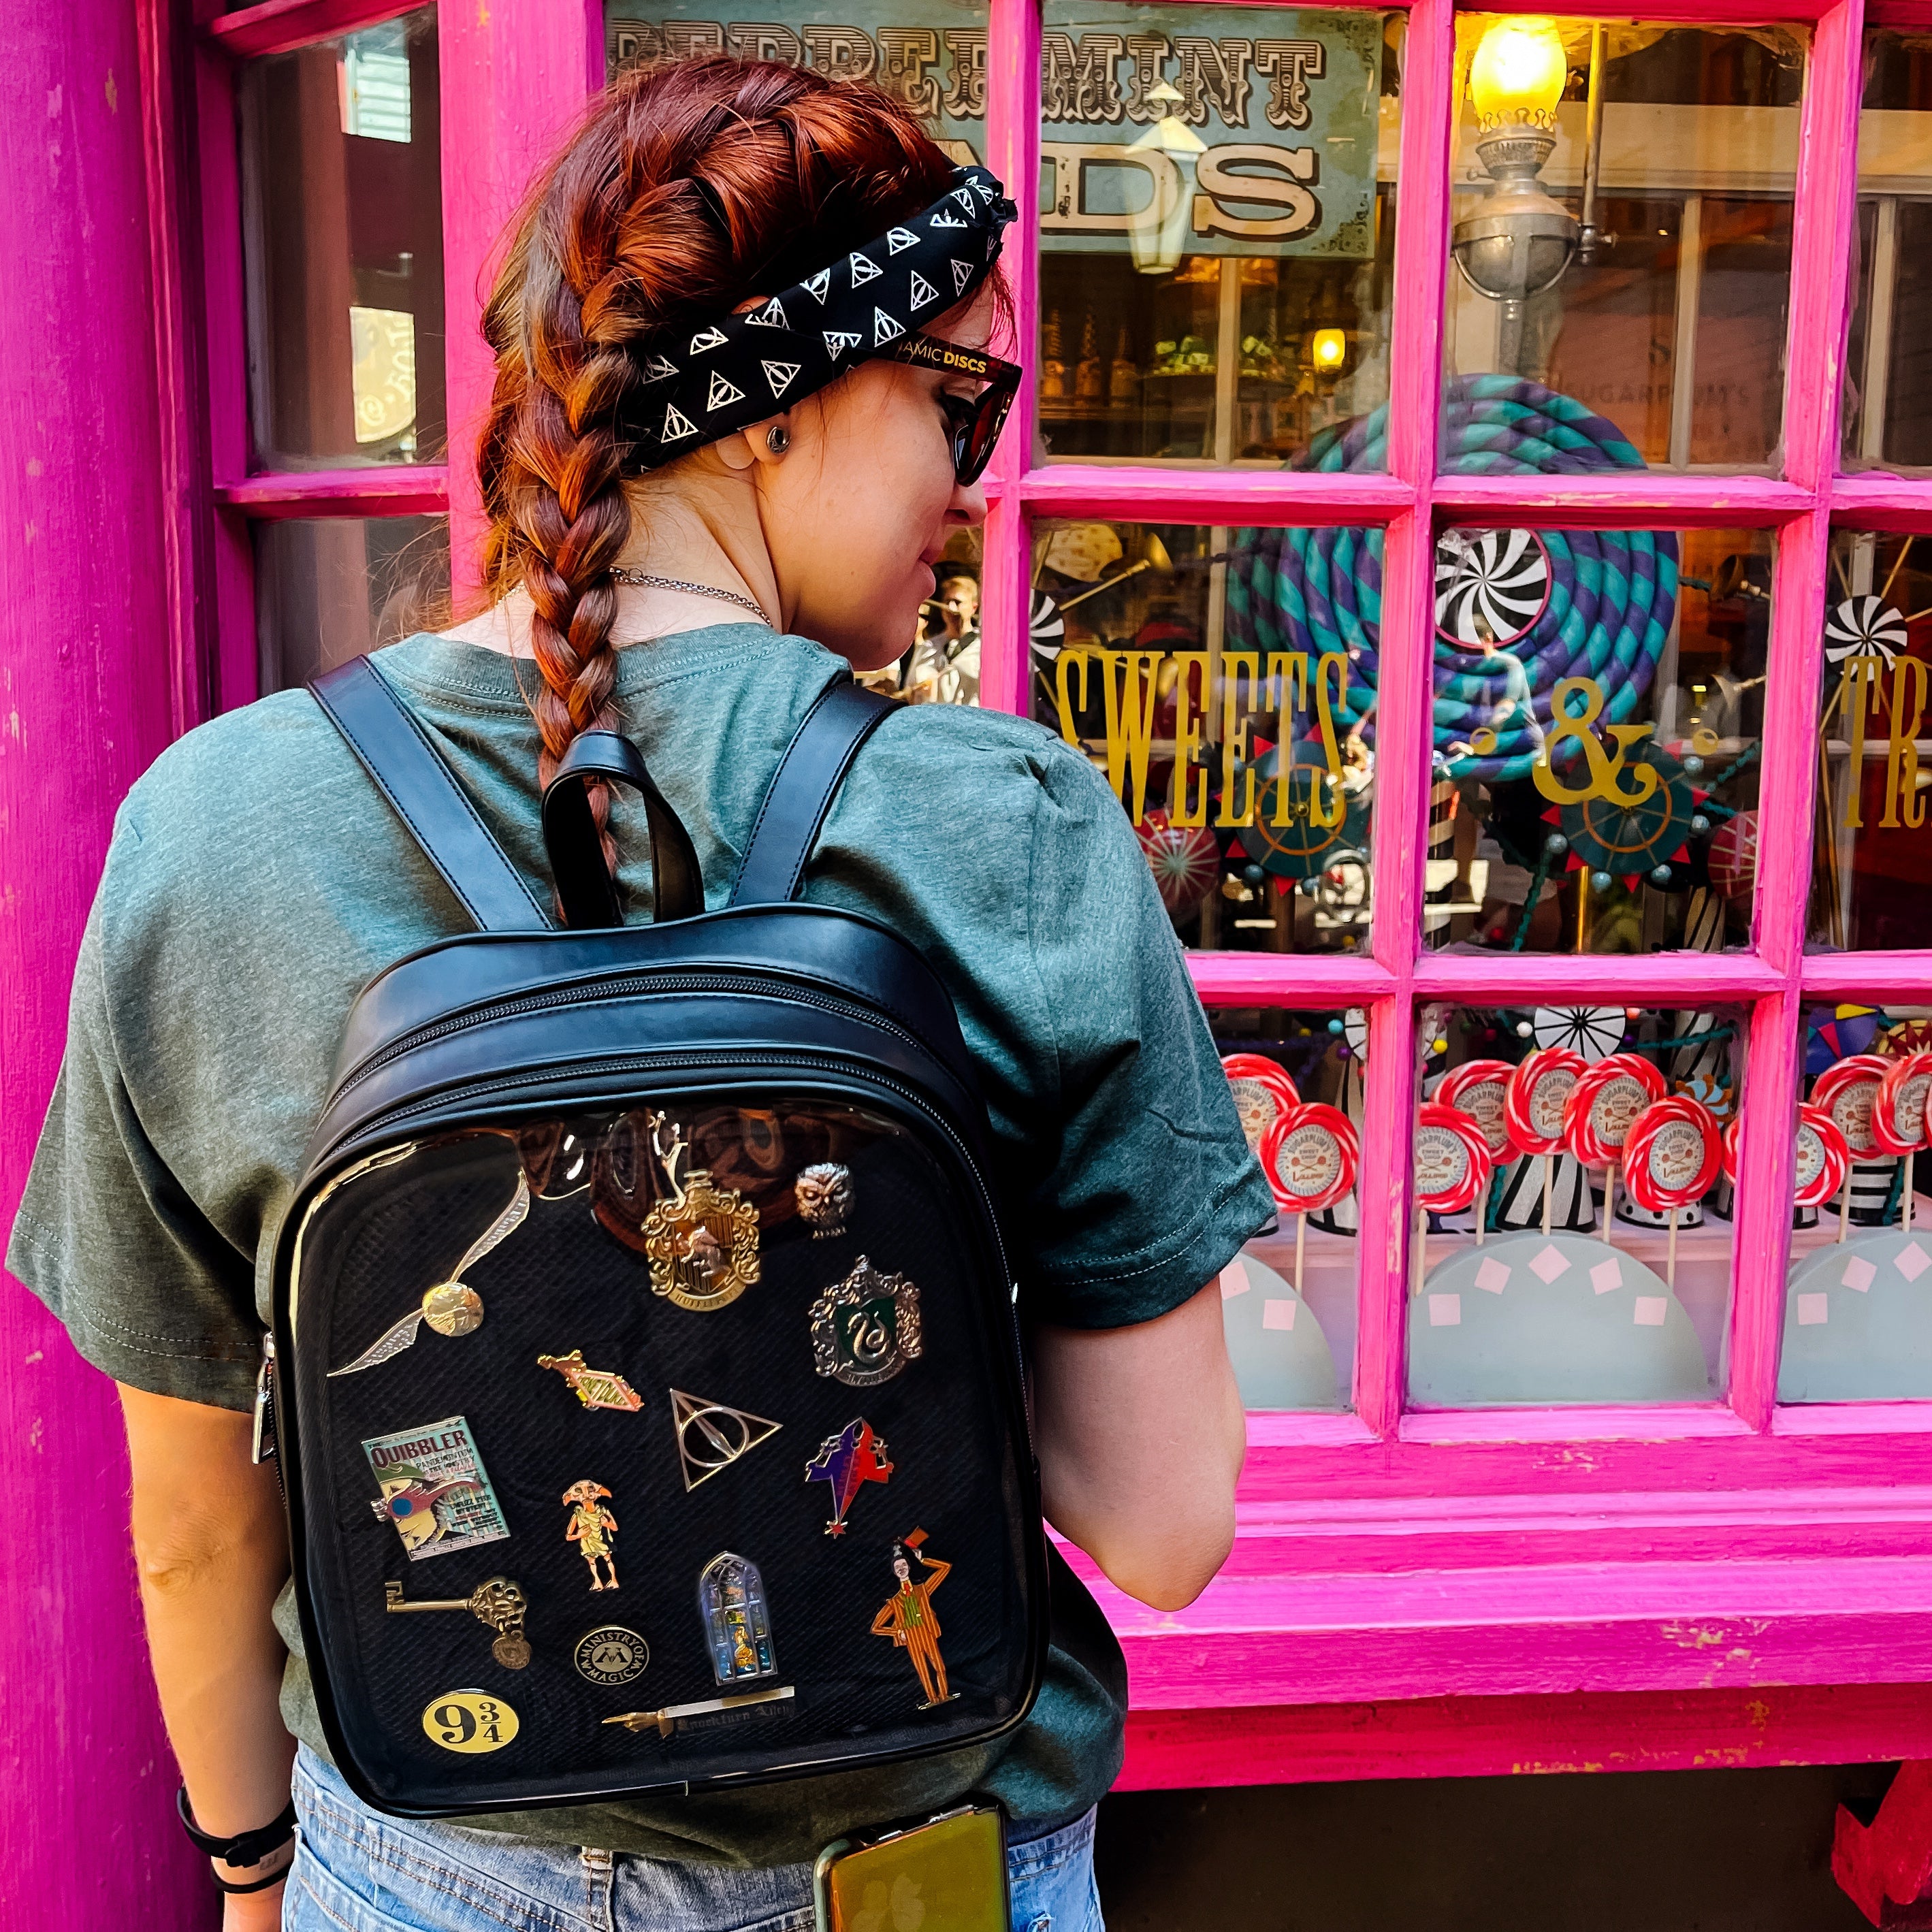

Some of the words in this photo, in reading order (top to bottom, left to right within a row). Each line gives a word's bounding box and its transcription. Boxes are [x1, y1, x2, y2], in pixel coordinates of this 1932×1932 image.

[944, 350, 986, 374] DISCS
[1057, 650, 1348, 828] SWEETS
[1532, 676, 1657, 806] &
[1840, 656, 1932, 828] TR
[370, 1430, 468, 1468] QUIBBLER
[580, 1632, 640, 1658] MINISTRY
[633, 1645, 645, 1660] OF
[587, 1669, 634, 1682] MAGIC
